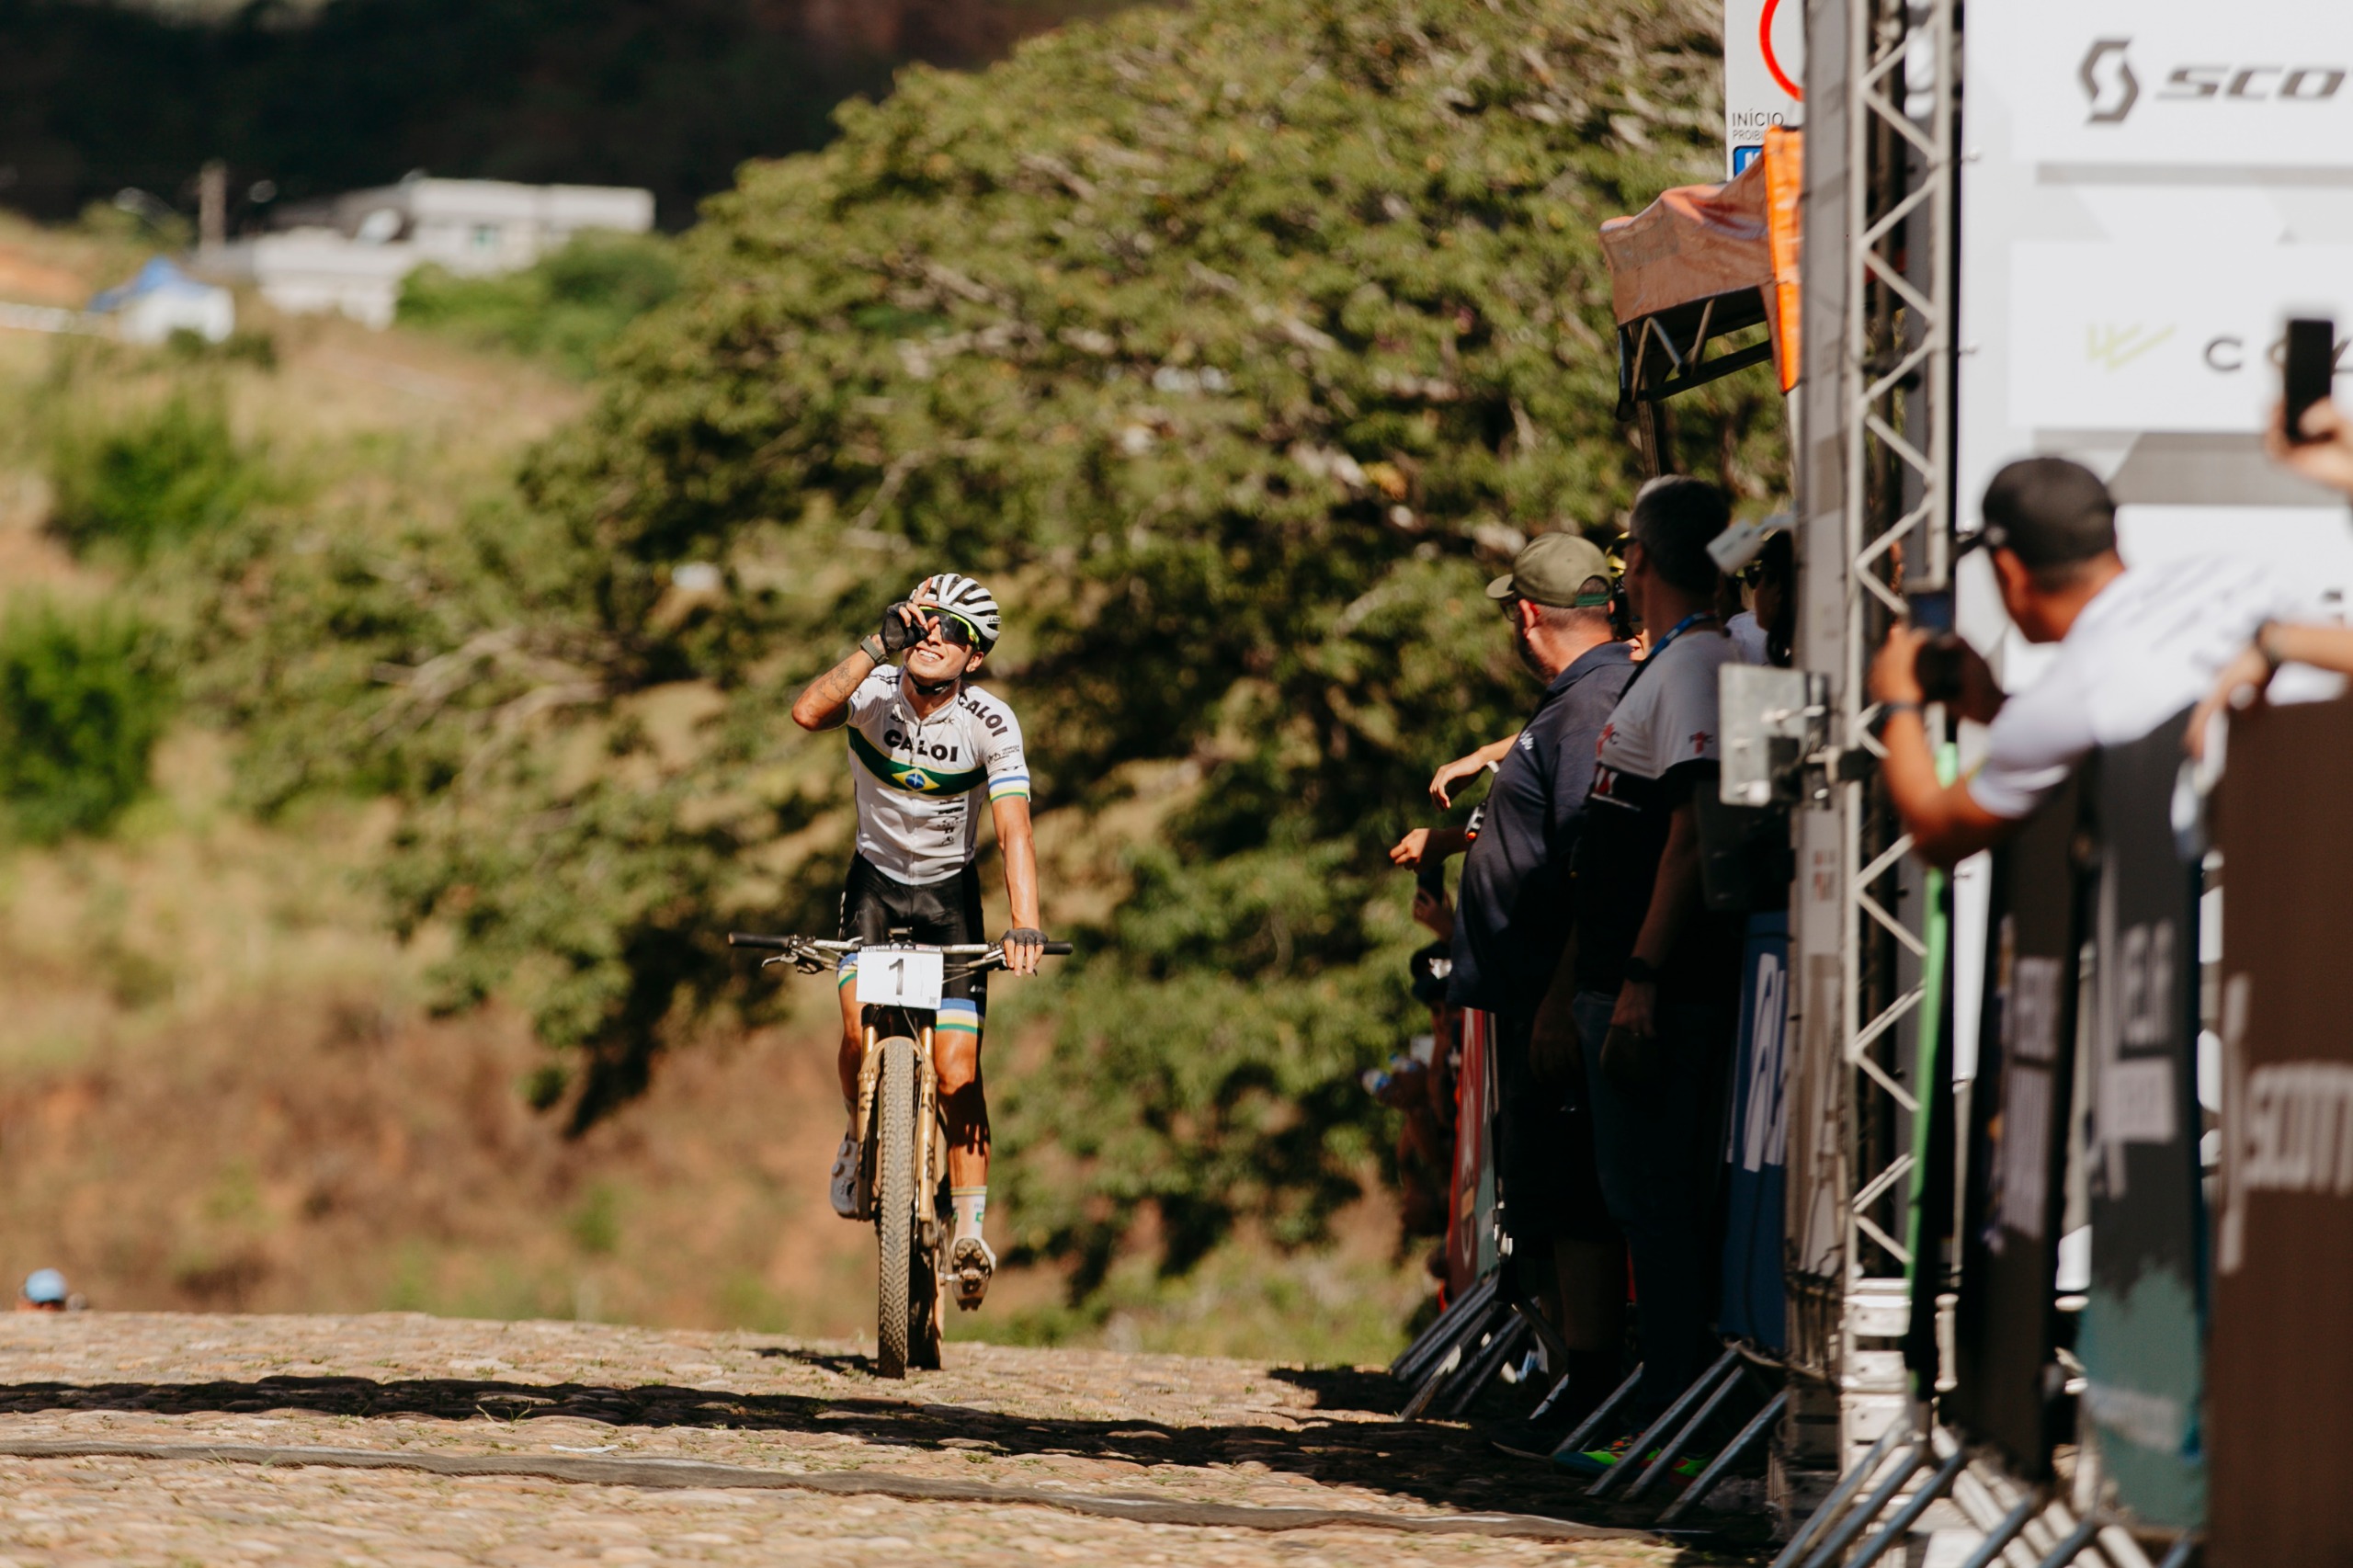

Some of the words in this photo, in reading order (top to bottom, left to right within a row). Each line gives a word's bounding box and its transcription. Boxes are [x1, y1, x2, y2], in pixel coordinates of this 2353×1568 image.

[2156, 62, 2353, 101] SCO
[1733, 108, 1784, 126] INÍCIO
[1733, 130, 1764, 141] PROIBI
[957, 691, 1008, 737] CALOI
[883, 729, 959, 762] CALOI
[888, 958, 904, 995] 1
